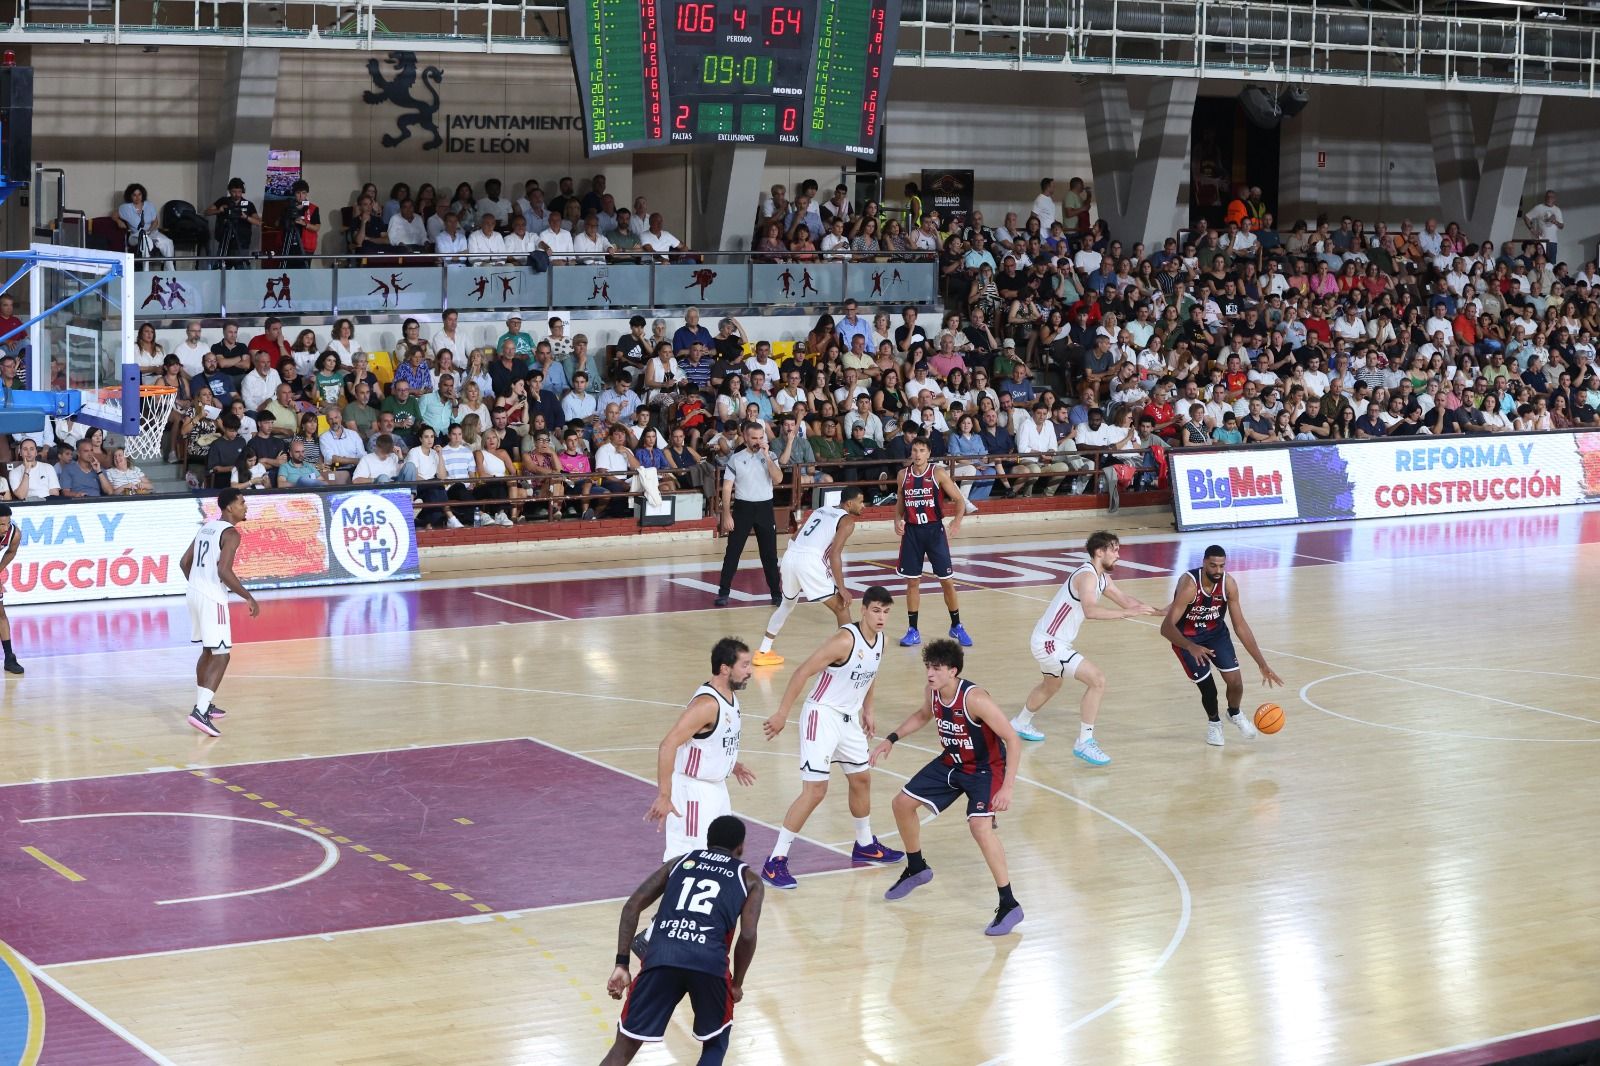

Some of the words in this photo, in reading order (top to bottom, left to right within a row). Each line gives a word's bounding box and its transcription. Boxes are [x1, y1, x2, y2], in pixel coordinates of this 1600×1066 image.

[594, 10, 600, 20] 3
[642, 7, 654, 17] 18
[677, 3, 714, 33] 106
[733, 9, 746, 30] 4
[771, 8, 800, 35] 64
[872, 9, 884, 20] 13
[594, 23, 600, 32] 4
[648, 18, 655, 29] 2
[827, 15, 833, 24] 2
[878, 21, 884, 32] 7
[594, 34, 601, 44] 6
[643, 31, 656, 41] 11
[726, 35, 752, 43] PERIODO
[826, 27, 831, 36] 5
[875, 33, 883, 43] 8
[644, 43, 656, 54] 19
[818, 49, 830, 59] 11
[819, 38, 831, 48] 10
[869, 44, 881, 55] 11
[595, 59, 602, 69] 8
[650, 55, 657, 66] 5
[703, 55, 773, 84] 09:01
[817, 61, 829, 71] 12
[872, 68, 879, 78] 5
[590, 71, 603, 81] 12
[645, 67, 658, 78] 10
[816, 73, 828, 82] 14
[591, 83, 603, 94] 20
[651, 79, 658, 90] 6
[772, 87, 803, 95] MONDO
[815, 84, 827, 94] 16
[870, 91, 877, 100] 2
[592, 95, 604, 106] 23
[652, 91, 658, 101] 4
[814, 96, 826, 106] 19
[863, 102, 875, 112] 10
[592, 107, 605, 118] 24
[652, 103, 659, 114] 8
[676, 105, 689, 129] 2
[813, 107, 824, 118] 25
[868, 114, 875, 124] 3
[451, 115, 584, 131] AYUNTAMIENTO
[593, 119, 605, 130] 30
[653, 115, 660, 125] 4
[783, 108, 796, 131] 0
[812, 119, 824, 130] 60
[867, 126, 874, 135] 5
[450, 138, 475, 153] DE
[480, 133, 529, 153] LEÓN
[594, 132, 606, 143] 33
[654, 127, 660, 138] 9
[718, 134, 755, 142] EXCLUSIONES
[779, 134, 799, 142] FALTAS
[592, 142, 624, 151] MONDO
[845, 145, 874, 154] MONDO
[1395, 444, 1512, 472] REFORMA
[1518, 443, 1534, 465] Y
[1187, 466, 1283, 508] BigMat
[1374, 470, 1561, 508] CONSTRUCCIÓN
[341, 505, 387, 527] Más
[915, 513, 929, 525] 10
[20, 515, 85, 546] MA
[98, 513, 125, 542] Y
[803, 518, 821, 536] 3
[343, 526, 380, 547] por
[197, 540, 209, 568] 12
[358, 538, 391, 572] ti
[950, 753, 963, 764] 11
[699, 850, 731, 863] BAUGH
[696, 864, 734, 878] AMUTIO
[675, 877, 721, 915] 12
[660, 918, 697, 930] araba
[668, 928, 706, 944] álava
